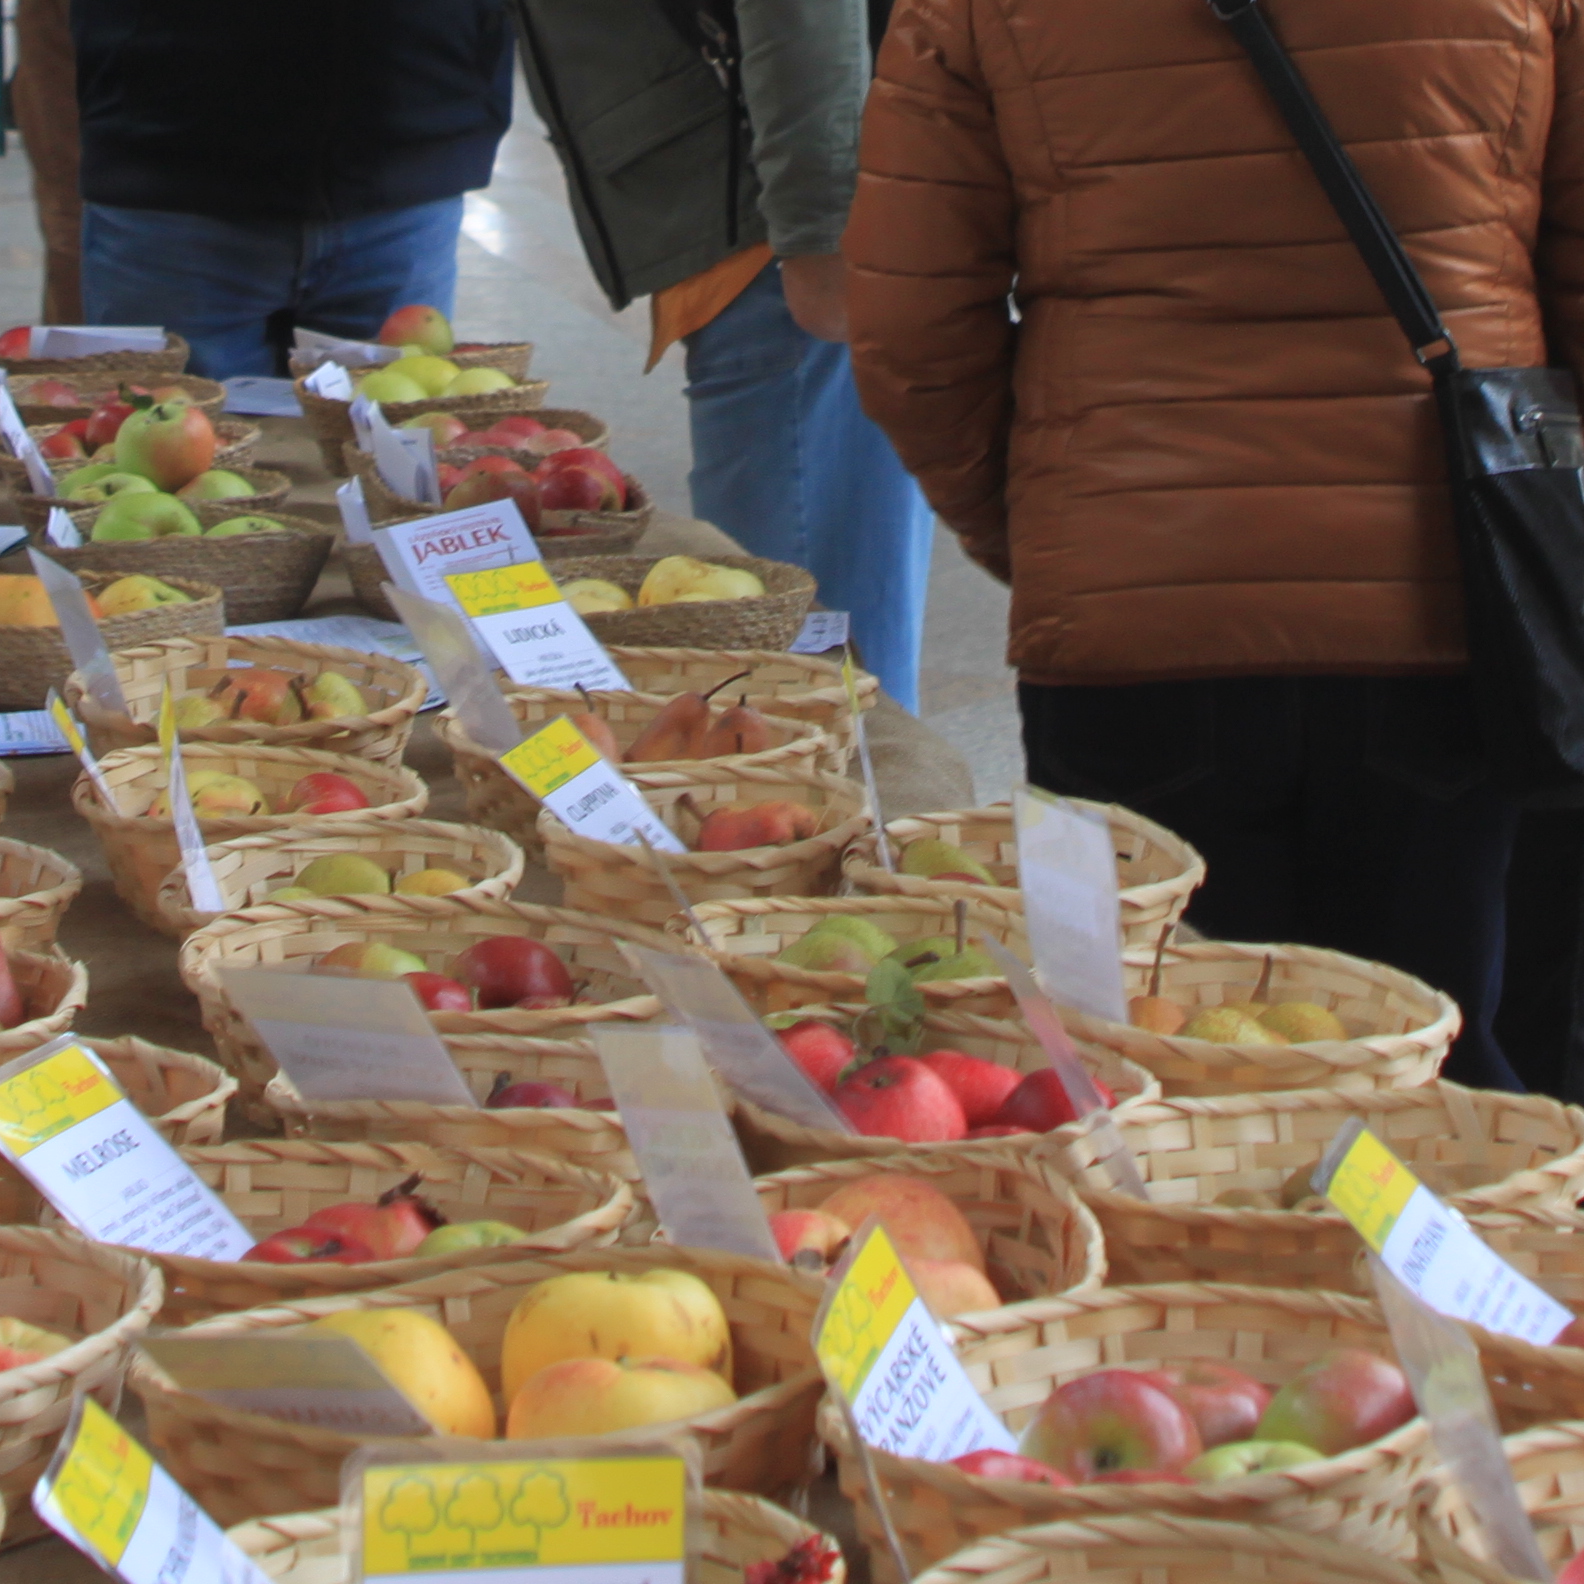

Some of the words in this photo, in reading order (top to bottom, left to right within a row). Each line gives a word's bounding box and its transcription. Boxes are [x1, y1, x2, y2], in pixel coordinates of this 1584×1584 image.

[410, 523, 513, 565] JABLEK
[502, 617, 566, 645] LIDICKÁ
[61, 1127, 142, 1183] MELROSE
[576, 1500, 675, 1530] Tachov
